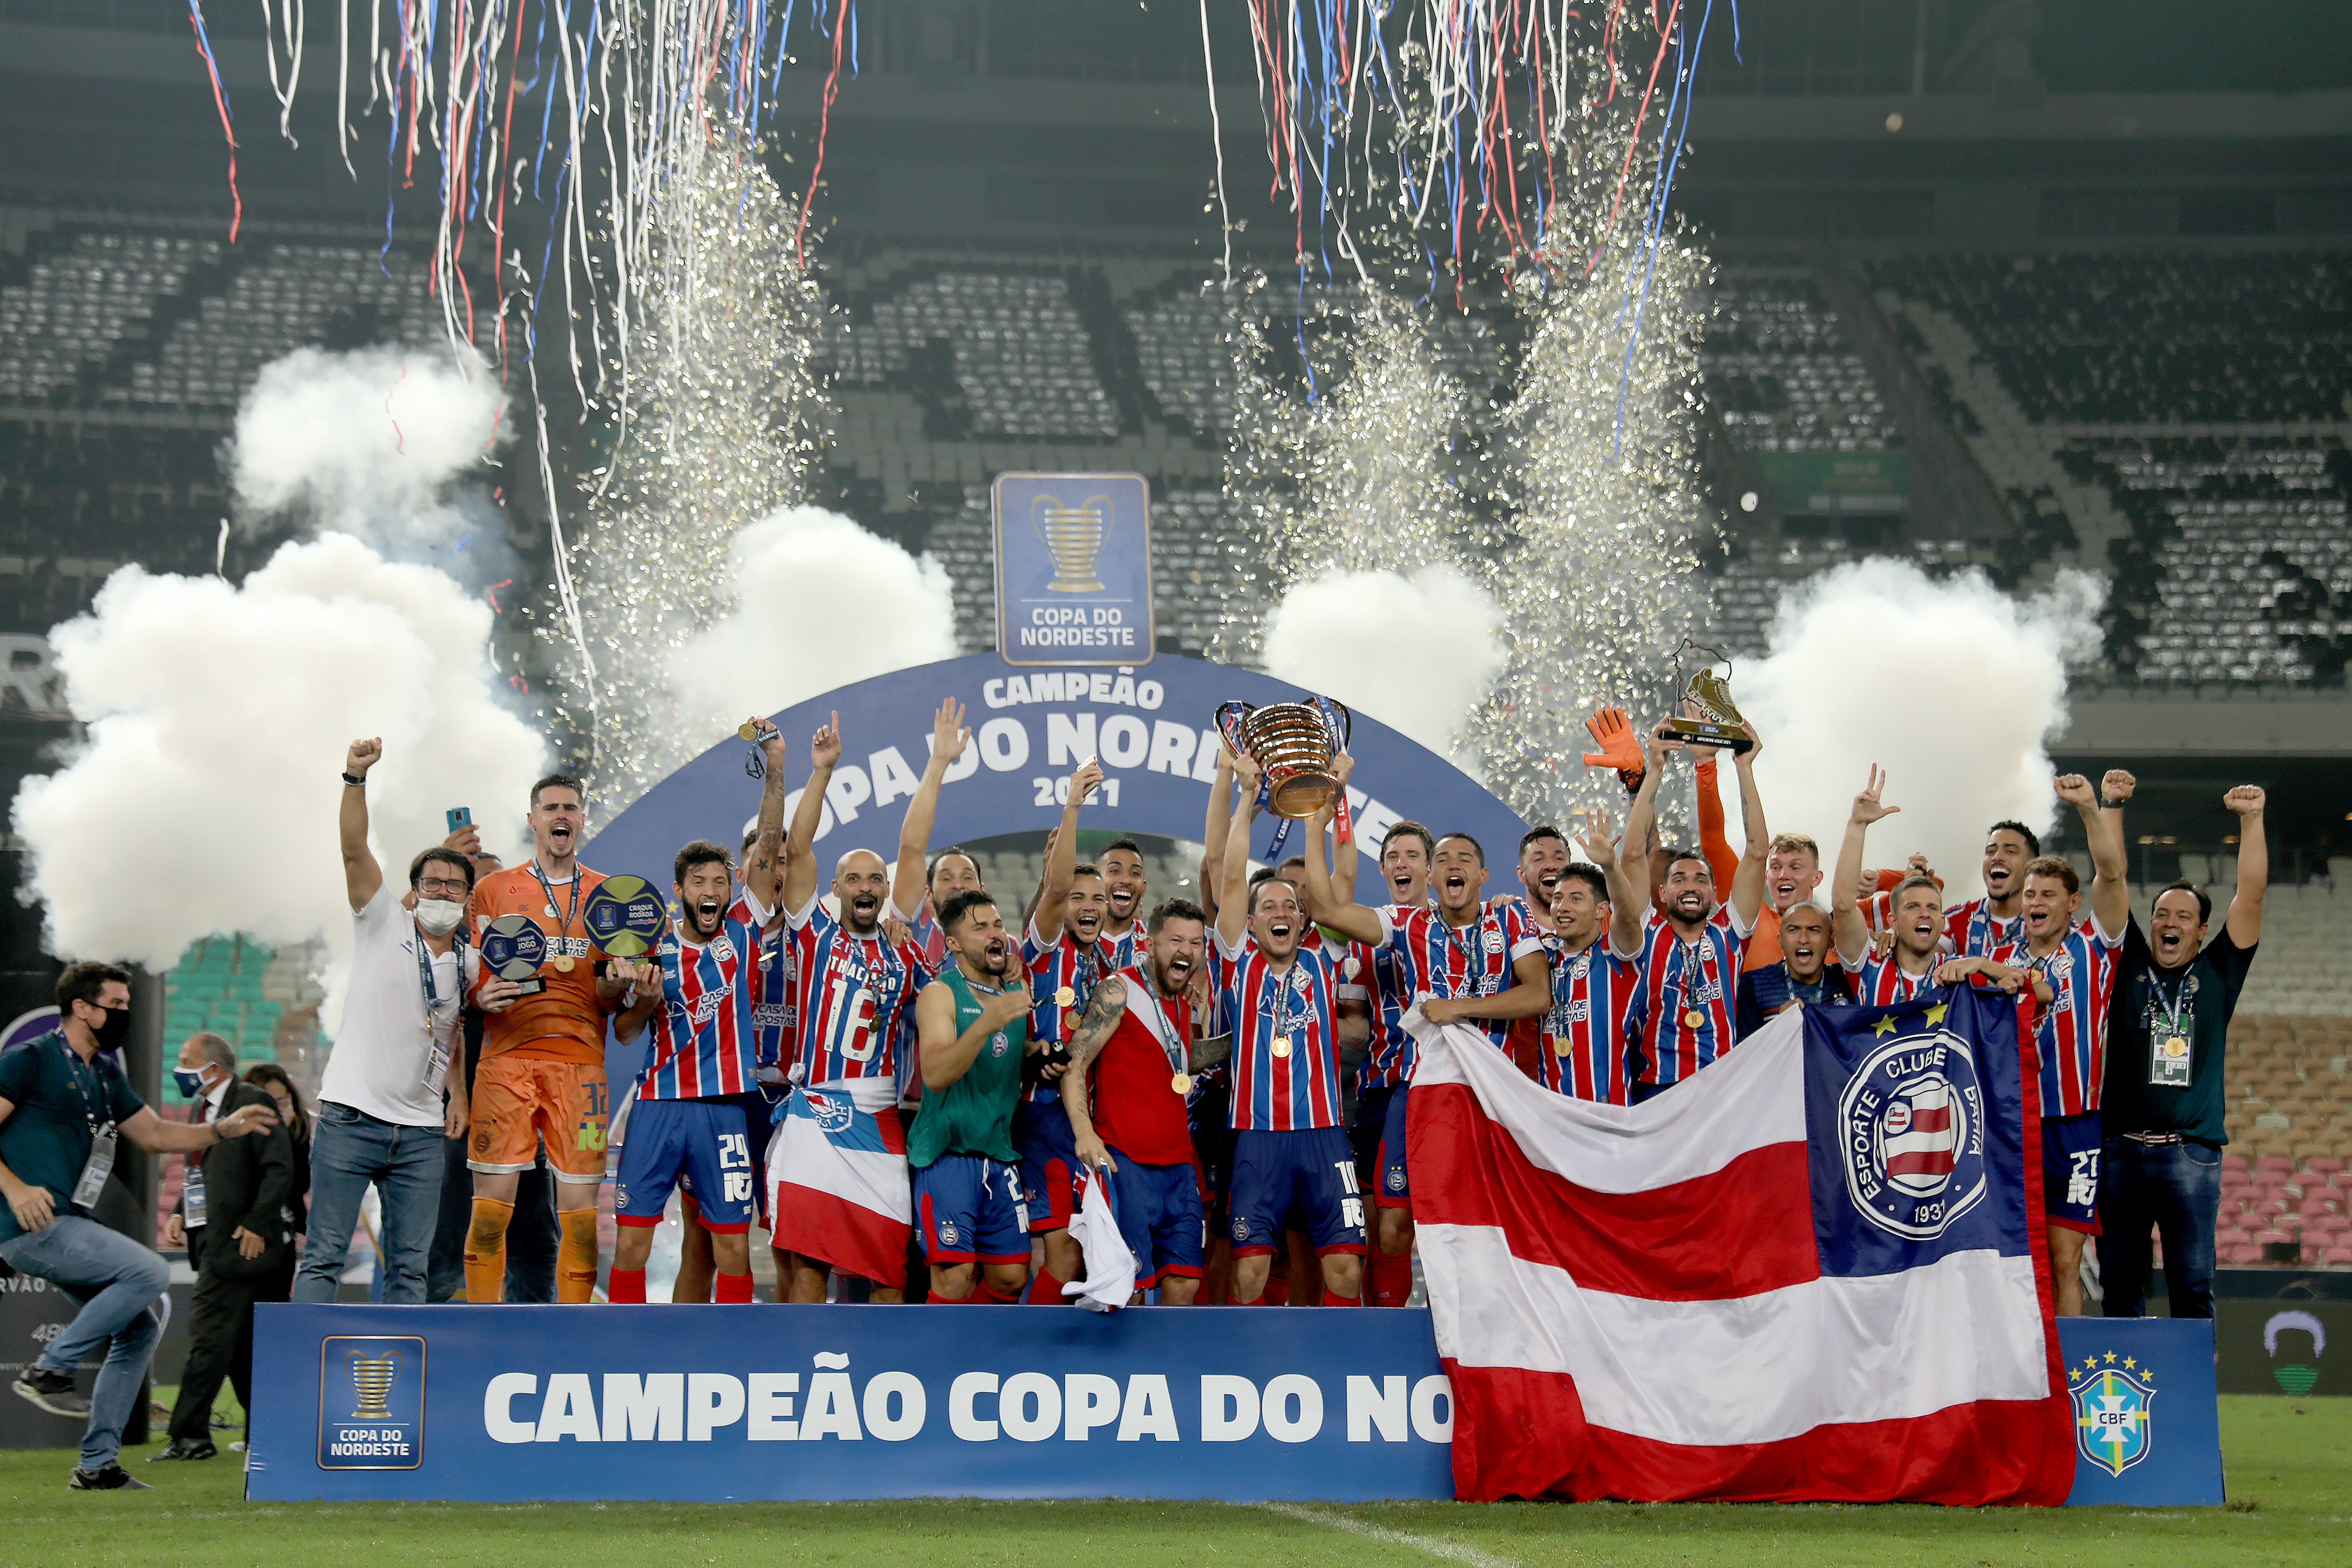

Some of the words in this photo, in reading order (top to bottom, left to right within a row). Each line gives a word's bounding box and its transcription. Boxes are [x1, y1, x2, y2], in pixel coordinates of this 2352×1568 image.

[1032, 608, 1087, 626] COPA
[1093, 608, 1122, 626] DO
[1020, 627, 1135, 646] NORDESTE
[983, 666, 1164, 710] CAMPEÃO
[518, 941, 536, 950] JOGO
[576, 938, 589, 947] DE
[759, 1004, 785, 1015] CASA
[1574, 1001, 1587, 1010] DE
[752, 1014, 797, 1026] APOSTAS
[824, 978, 887, 1062] 16
[1886, 1048, 1947, 1078] CLUBE
[718, 1134, 750, 1169] 29
[1852, 1090, 1881, 1201] ESPORTE
[1915, 1199, 1946, 1223] 1931
[484, 1351, 926, 1444] CAMPEÃO
[948, 1371, 1179, 1442] COPA
[1200, 1374, 1324, 1443] DO
[2099, 1412, 2127, 1425] CBF
[339, 1430, 378, 1441] COPA
[381, 1430, 402, 1441] DO
[331, 1443, 410, 1456] NORDESTE
